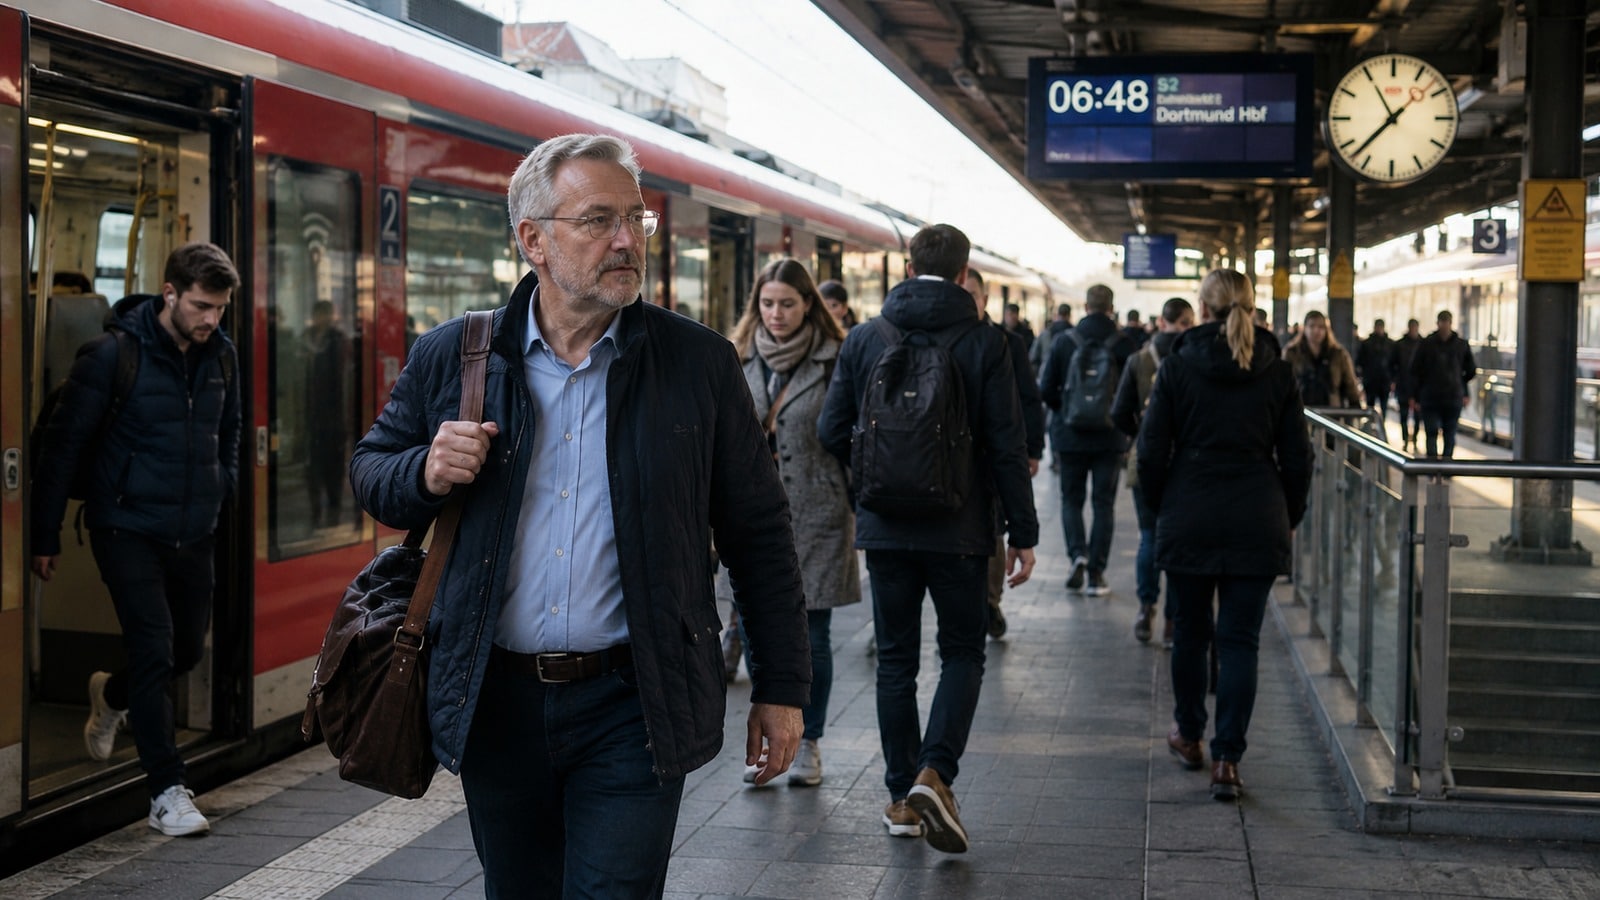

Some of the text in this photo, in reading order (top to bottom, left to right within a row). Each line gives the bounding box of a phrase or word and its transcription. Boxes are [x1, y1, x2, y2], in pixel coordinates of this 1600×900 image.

[1048, 80, 1149, 113] 06:48
[1157, 77, 1179, 92] S2
[1156, 106, 1267, 122] Dortmund Hbf
[383, 191, 398, 237] 2
[1479, 219, 1500, 250] 3
